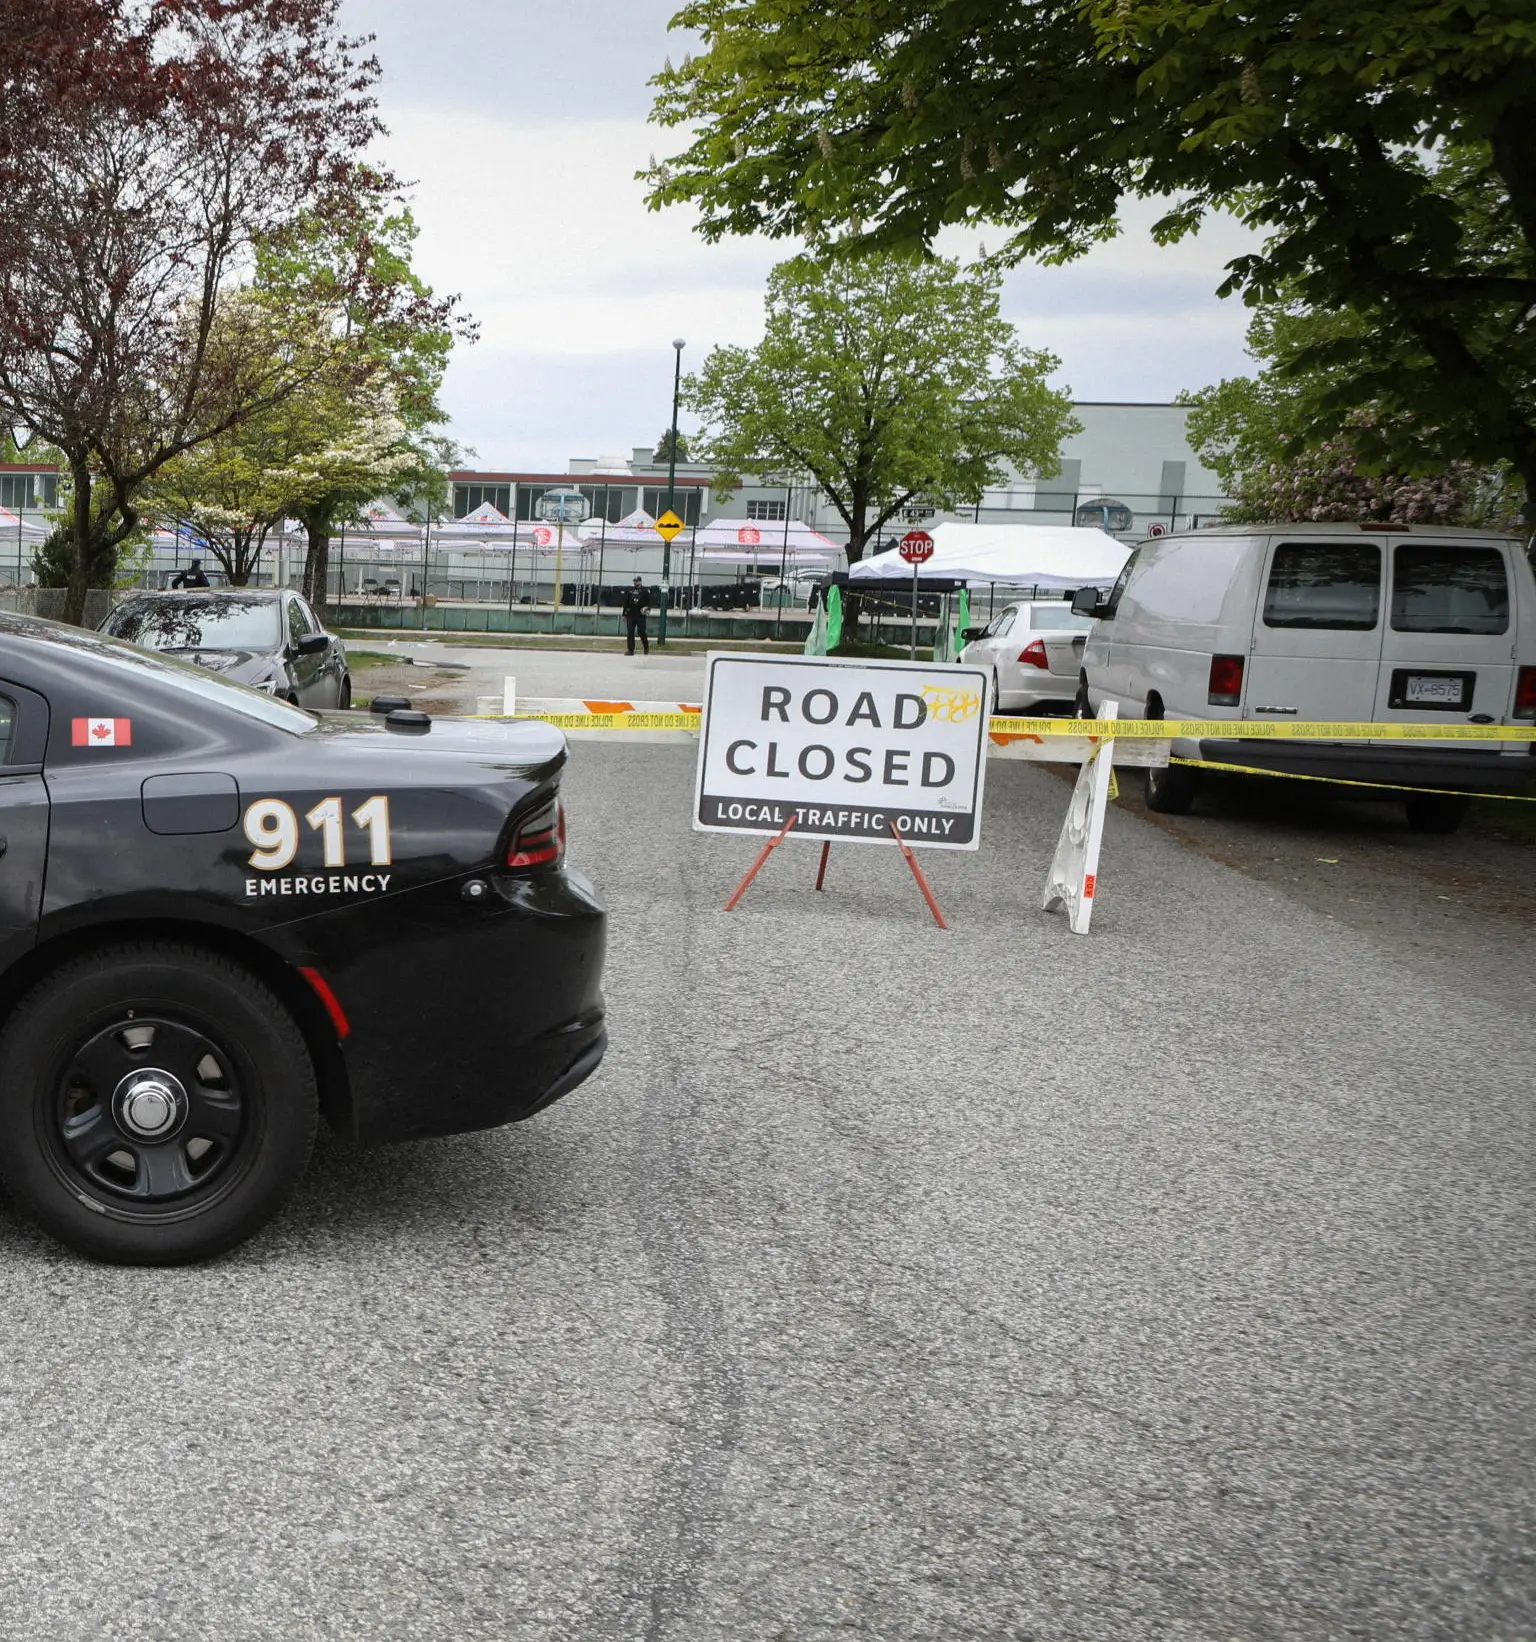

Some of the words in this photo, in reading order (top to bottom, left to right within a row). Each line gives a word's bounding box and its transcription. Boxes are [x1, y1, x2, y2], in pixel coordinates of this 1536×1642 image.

[900, 540, 933, 554] STOP
[760, 685, 928, 730] ROAD
[725, 739, 955, 788] CLOSED
[243, 795, 392, 870] 911
[717, 802, 783, 823] LOCAL
[795, 808, 884, 830] TRAFFIC
[896, 815, 955, 835] ONLY
[245, 874, 392, 896] EMERGENCY
